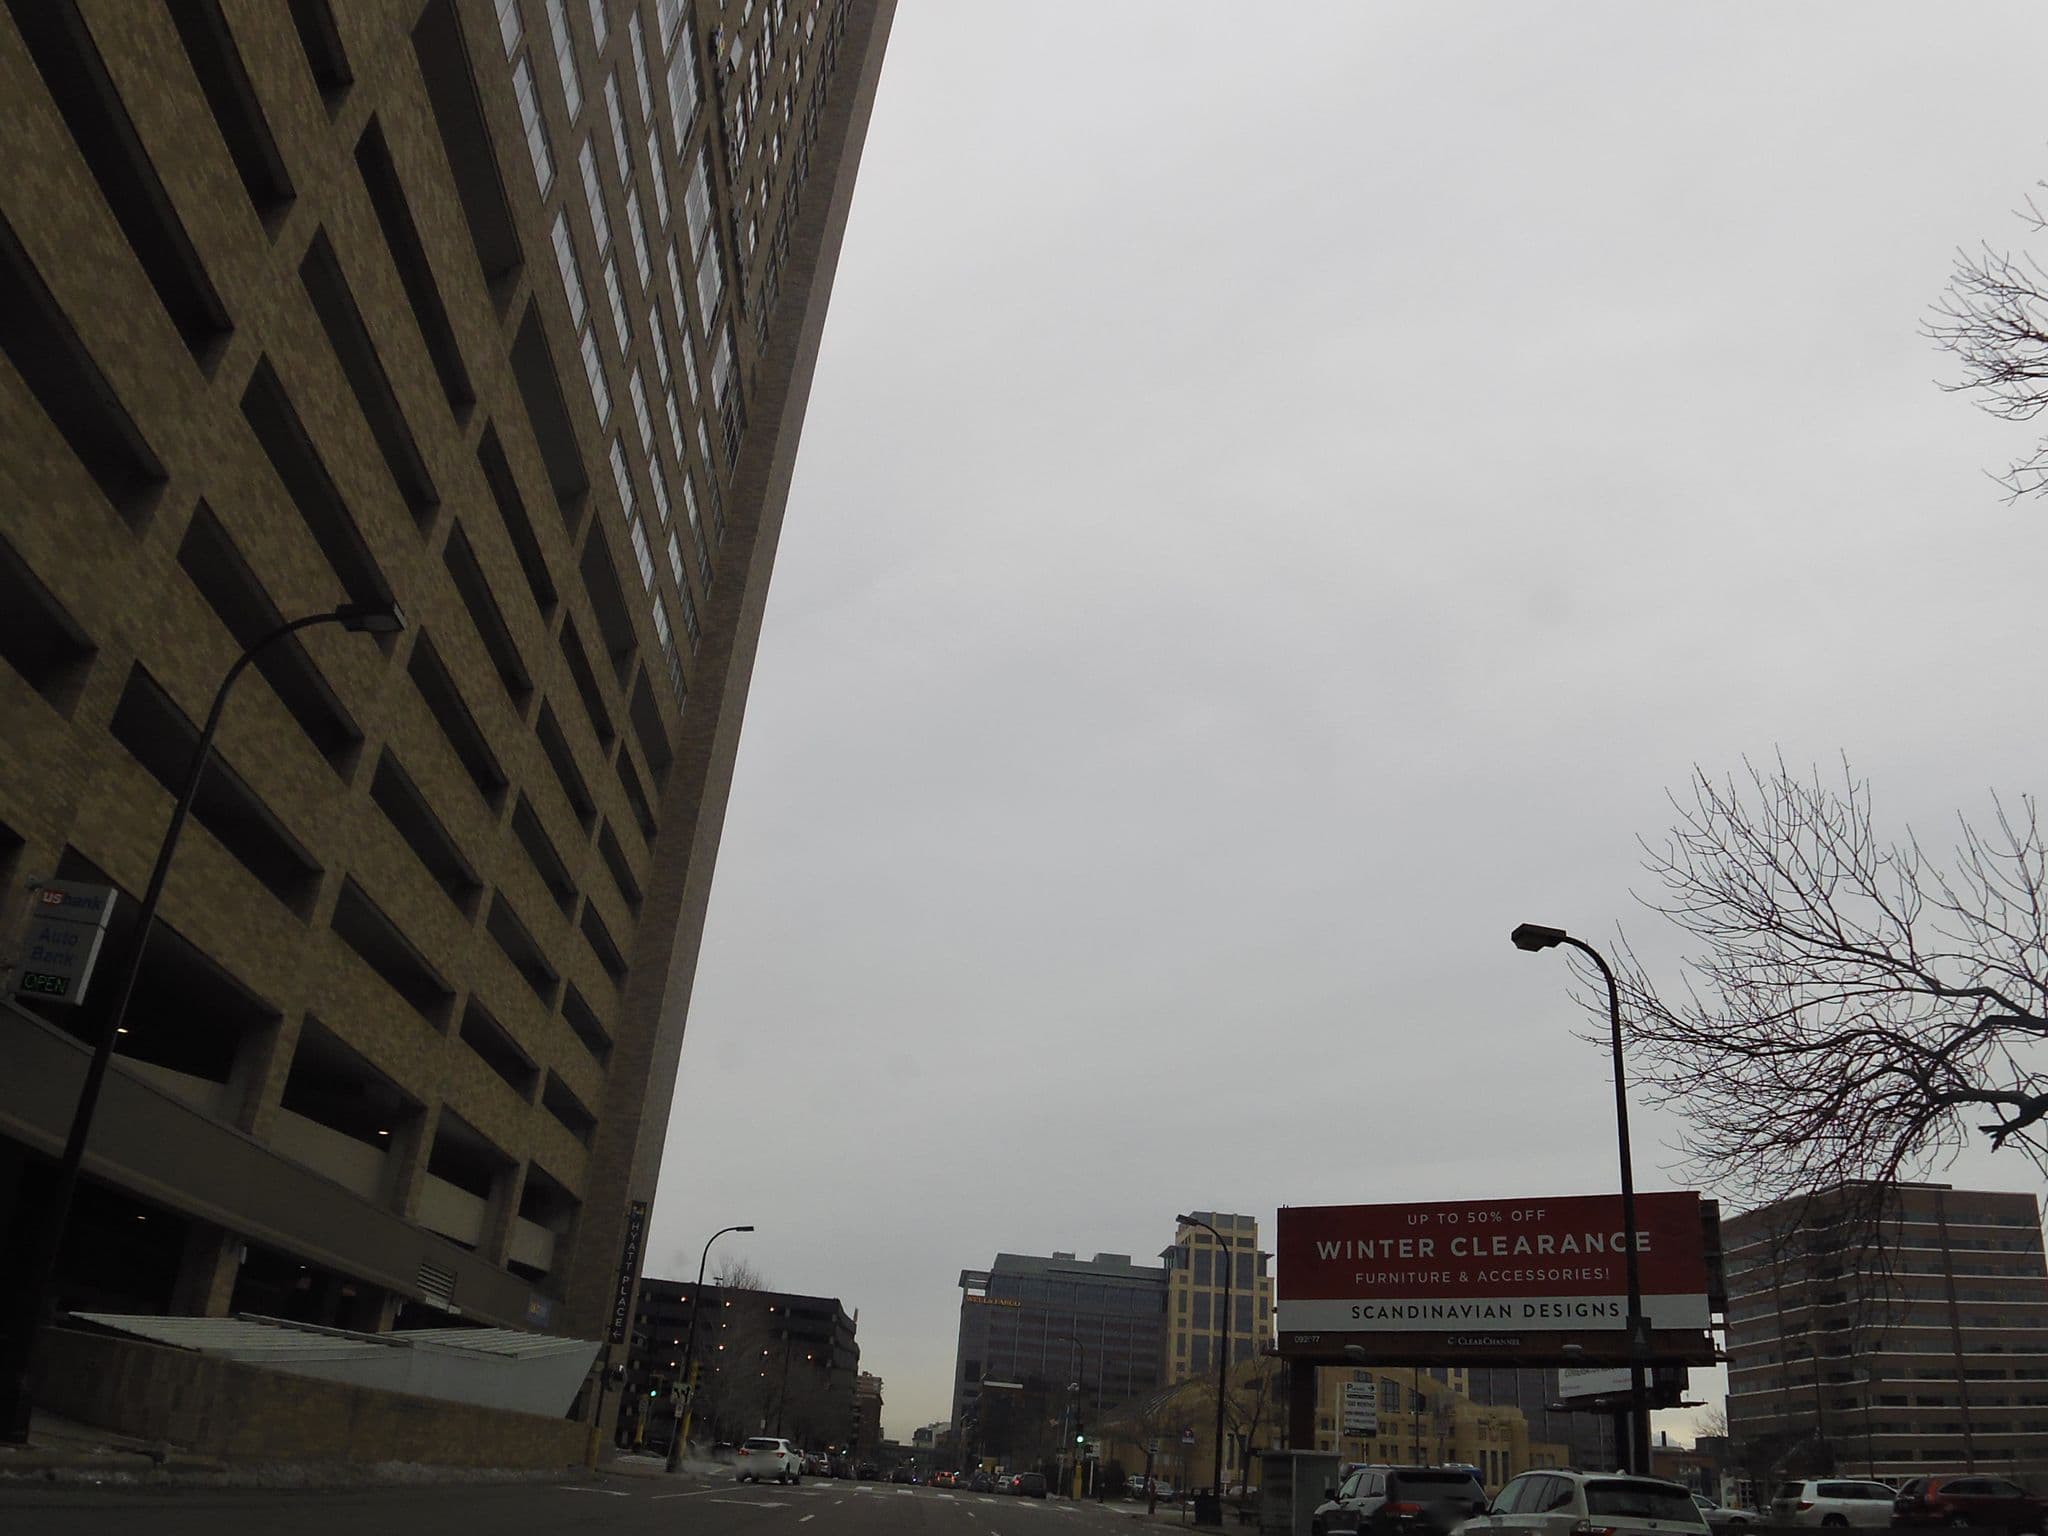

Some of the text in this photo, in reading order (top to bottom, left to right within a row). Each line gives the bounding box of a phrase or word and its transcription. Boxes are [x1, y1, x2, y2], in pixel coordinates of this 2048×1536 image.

[24, 974, 65, 993] OPEN
[1407, 1209, 1546, 1225] UP TO 50% OFF
[626, 1223, 639, 1272] HYATT
[1316, 1232, 1651, 1260] WINTER CLEARANCE
[1355, 1267, 1610, 1284] FURNITURE & ACCESSORIES!
[615, 1276, 630, 1327] PLACE
[1351, 1302, 1620, 1320] SCANDINAVIAN DESIGNS
